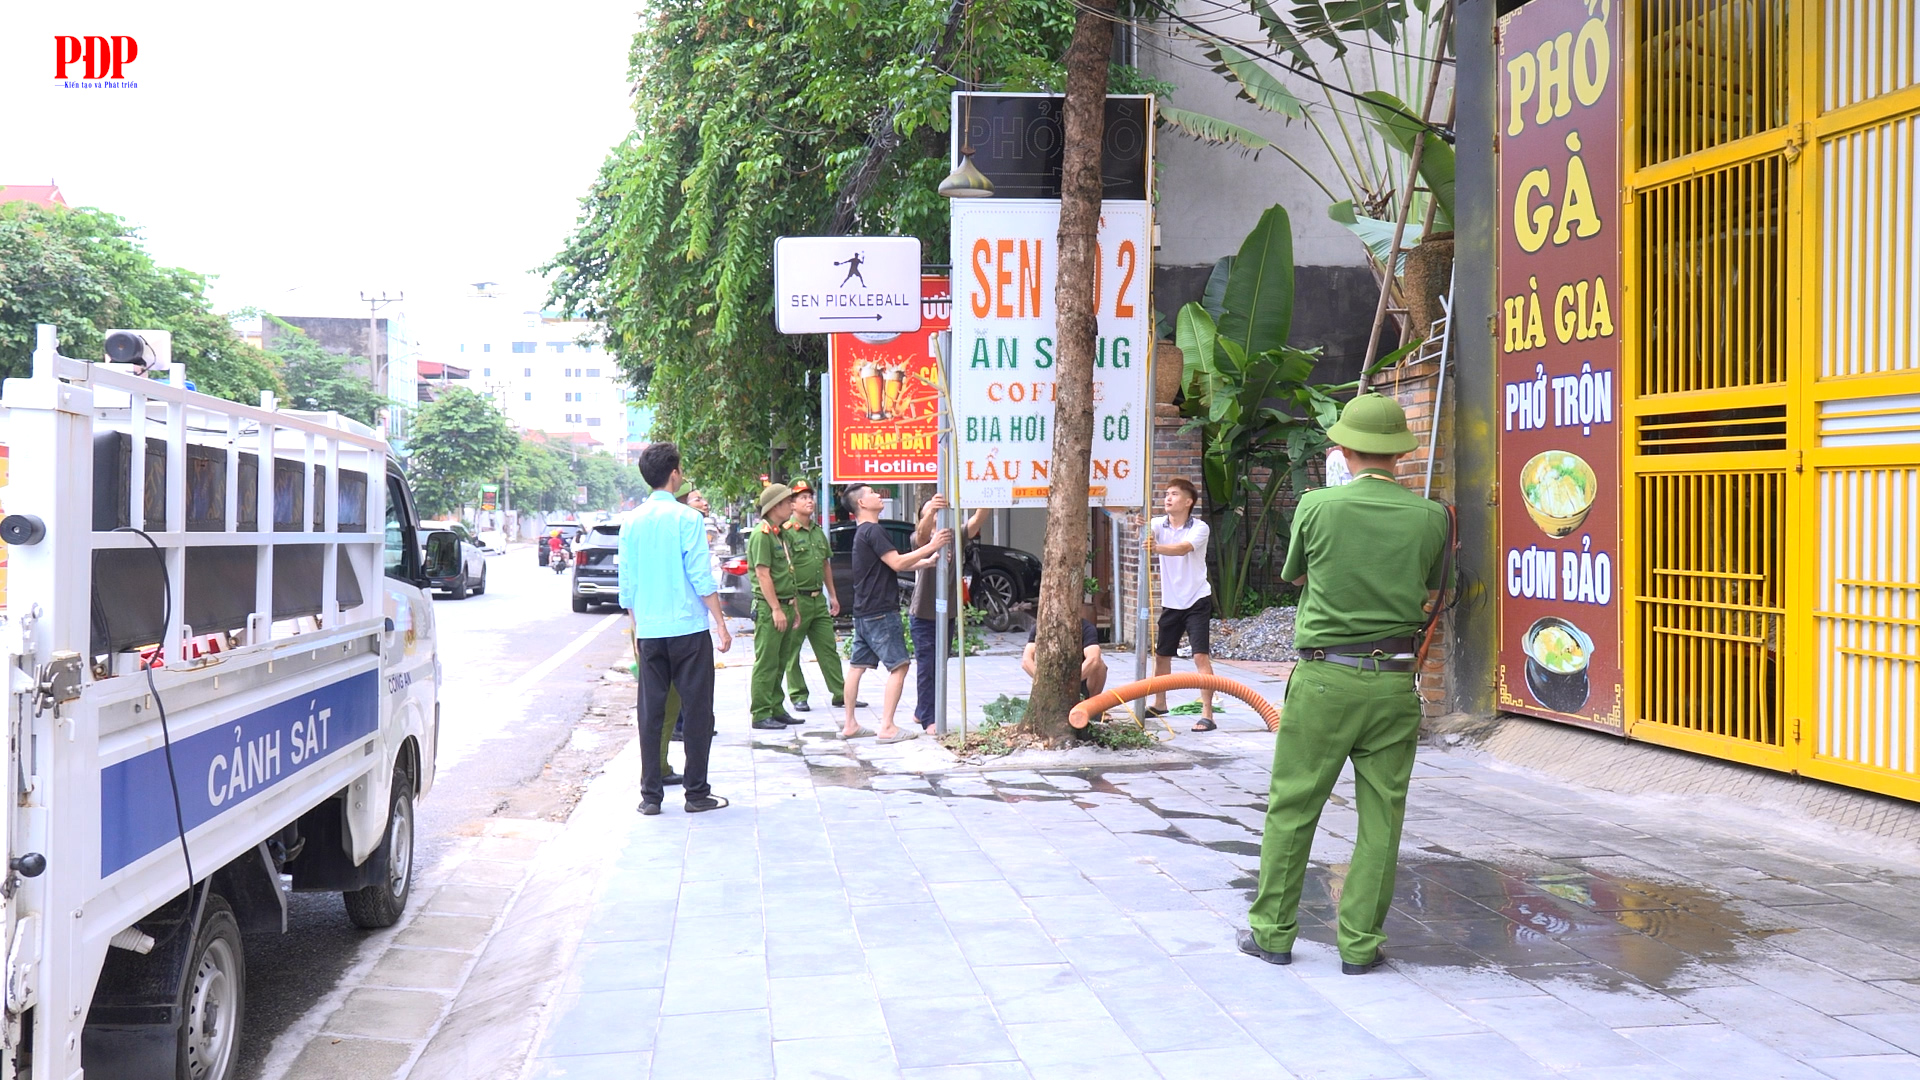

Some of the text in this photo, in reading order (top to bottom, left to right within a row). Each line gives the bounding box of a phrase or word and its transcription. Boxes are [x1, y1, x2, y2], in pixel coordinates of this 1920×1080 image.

[1514, 131, 1601, 253] GÀ
[971, 238, 1042, 319] SEN
[1115, 240, 1136, 318] 2
[791, 293, 910, 307] SEN PICKLEBALL
[1504, 276, 1614, 353] HÀ GIA
[970, 328, 1018, 369] ĂN
[988, 382, 1105, 402] COFE
[1505, 362, 1612, 436] PHỞ TRỘN
[850, 429, 932, 454] NHẬN ĐẶT
[966, 416, 1000, 442] BIA
[1010, 412, 1046, 442] HƠI
[864, 459, 938, 474] Hotline
[965, 447, 1131, 481] LẨU NNG
[1507, 534, 1611, 605] CƠM ĐẢO
[388, 671, 412, 694] CÔNG AN
[207, 699, 331, 807] CẢNH SÁT
